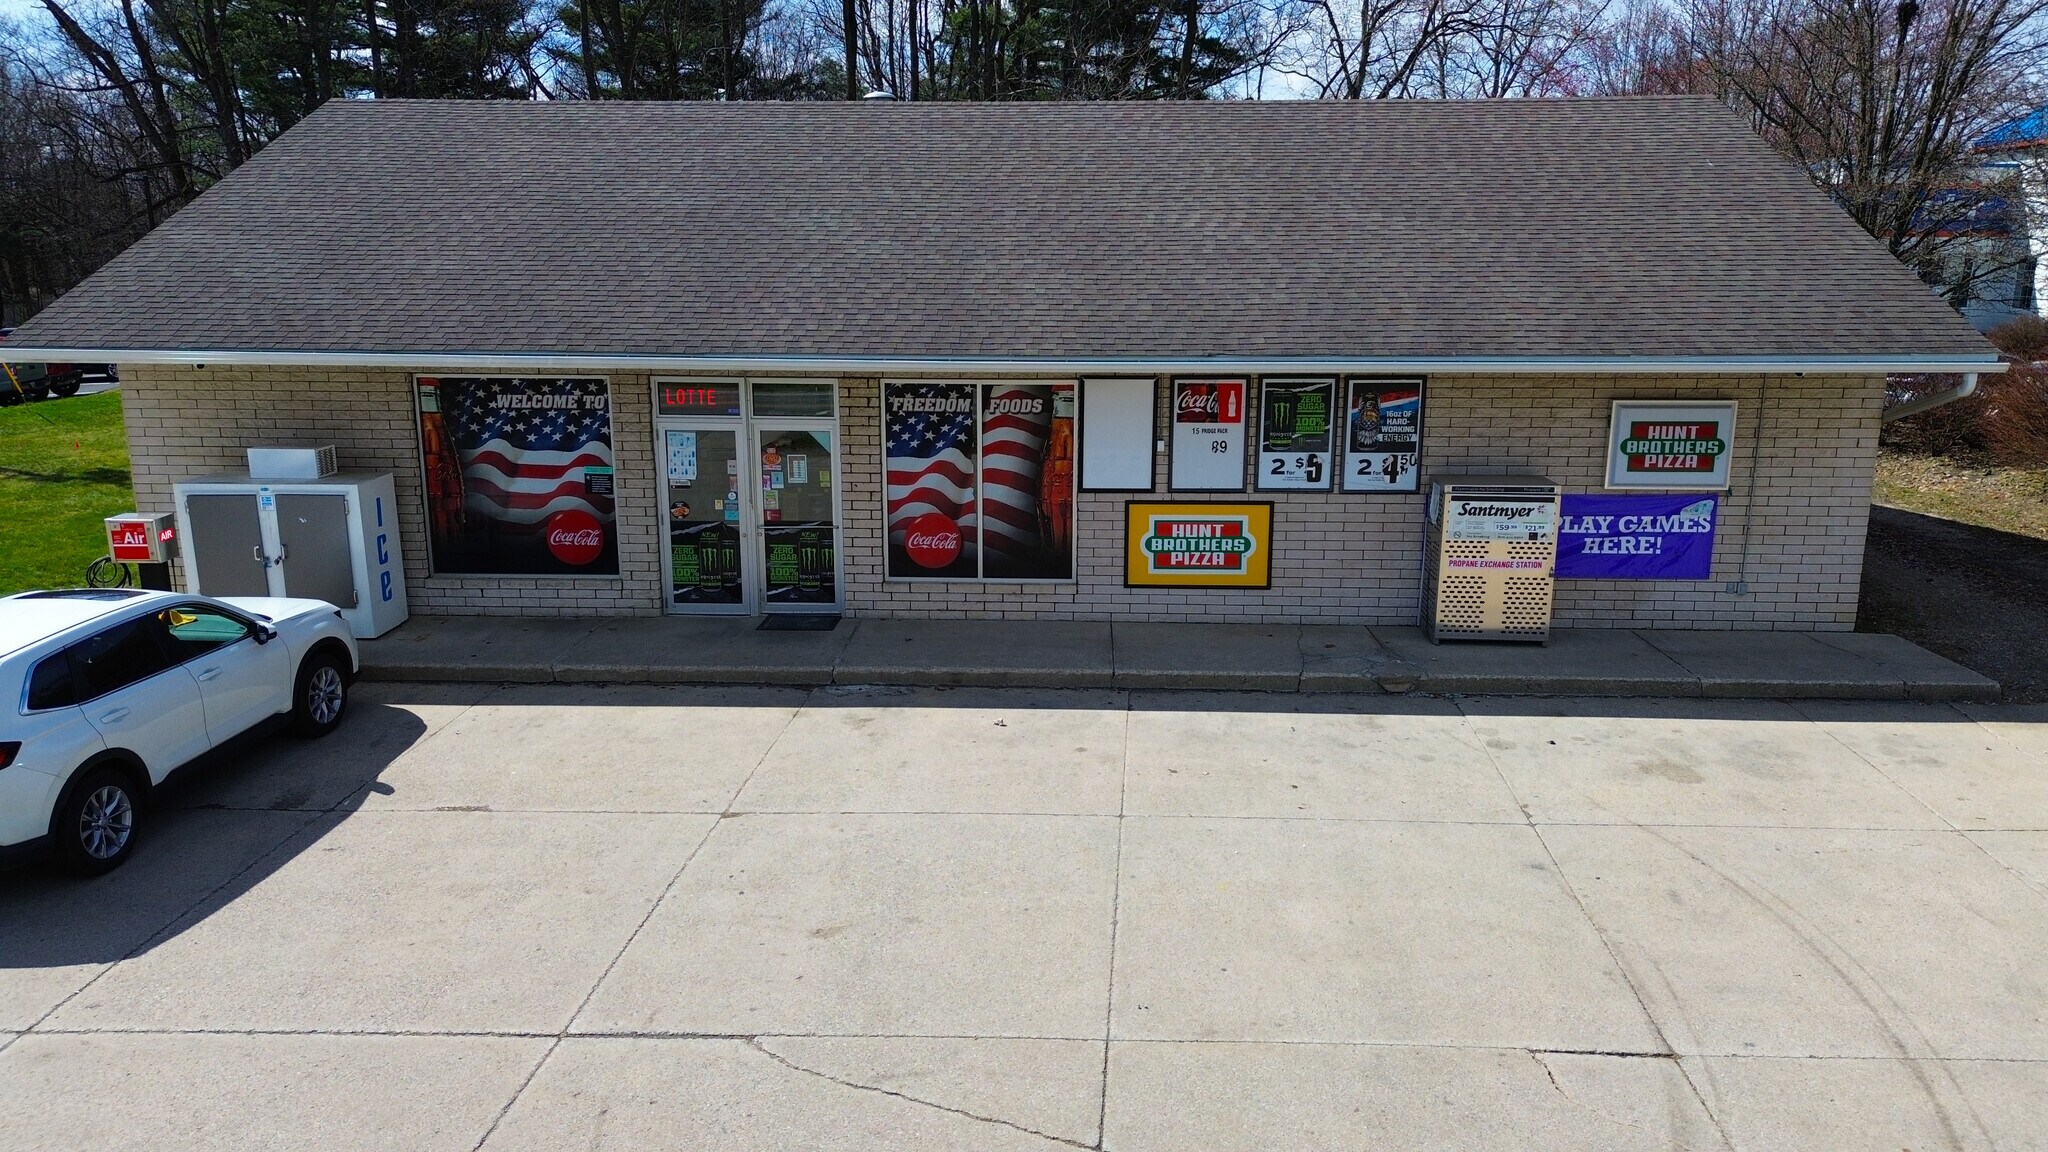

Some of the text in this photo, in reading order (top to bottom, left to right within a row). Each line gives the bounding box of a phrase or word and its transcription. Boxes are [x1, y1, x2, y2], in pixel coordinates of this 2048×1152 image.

[496, 394, 606, 410] WELCOME TO
[666, 388, 716, 405] LOTTE
[892, 398, 1043, 414] FREEDOM FOODS
[1386, 410, 1413, 418] 16oz OF
[1296, 417, 1325, 426] 100%
[1381, 425, 1416, 433] WORKING
[1648, 425, 1699, 440] HUNT
[1382, 434, 1414, 442] ENERGY
[1626, 440, 1719, 453] BROTHERS
[1271, 458, 1285, 475] 2
[1357, 458, 1372, 475] 2
[1644, 454, 1698, 468] PIZZA
[1458, 502, 1535, 520] Santmyer
[1172, 524, 1224, 538] HUNT
[1618, 514, 1711, 534] GAMES
[123, 531, 145, 544] Air
[160, 529, 173, 542] AIR
[550, 528, 601, 546] Coca-Cola
[701, 531, 720, 539] NEW!
[800, 531, 820, 539] NEW!
[908, 532, 960, 549] Coca-Cola
[673, 547, 695, 555] ZERO
[1151, 538, 1246, 552] BROTHERS
[1581, 536, 1662, 555] HERE!
[672, 554, 698, 562] SUGAR
[770, 553, 797, 561] SUGAR
[1170, 552, 1225, 566] PIZZA
[1448, 559, 1543, 569] PROPANE EXCHANGE STATION
[770, 568, 798, 576] 100%
